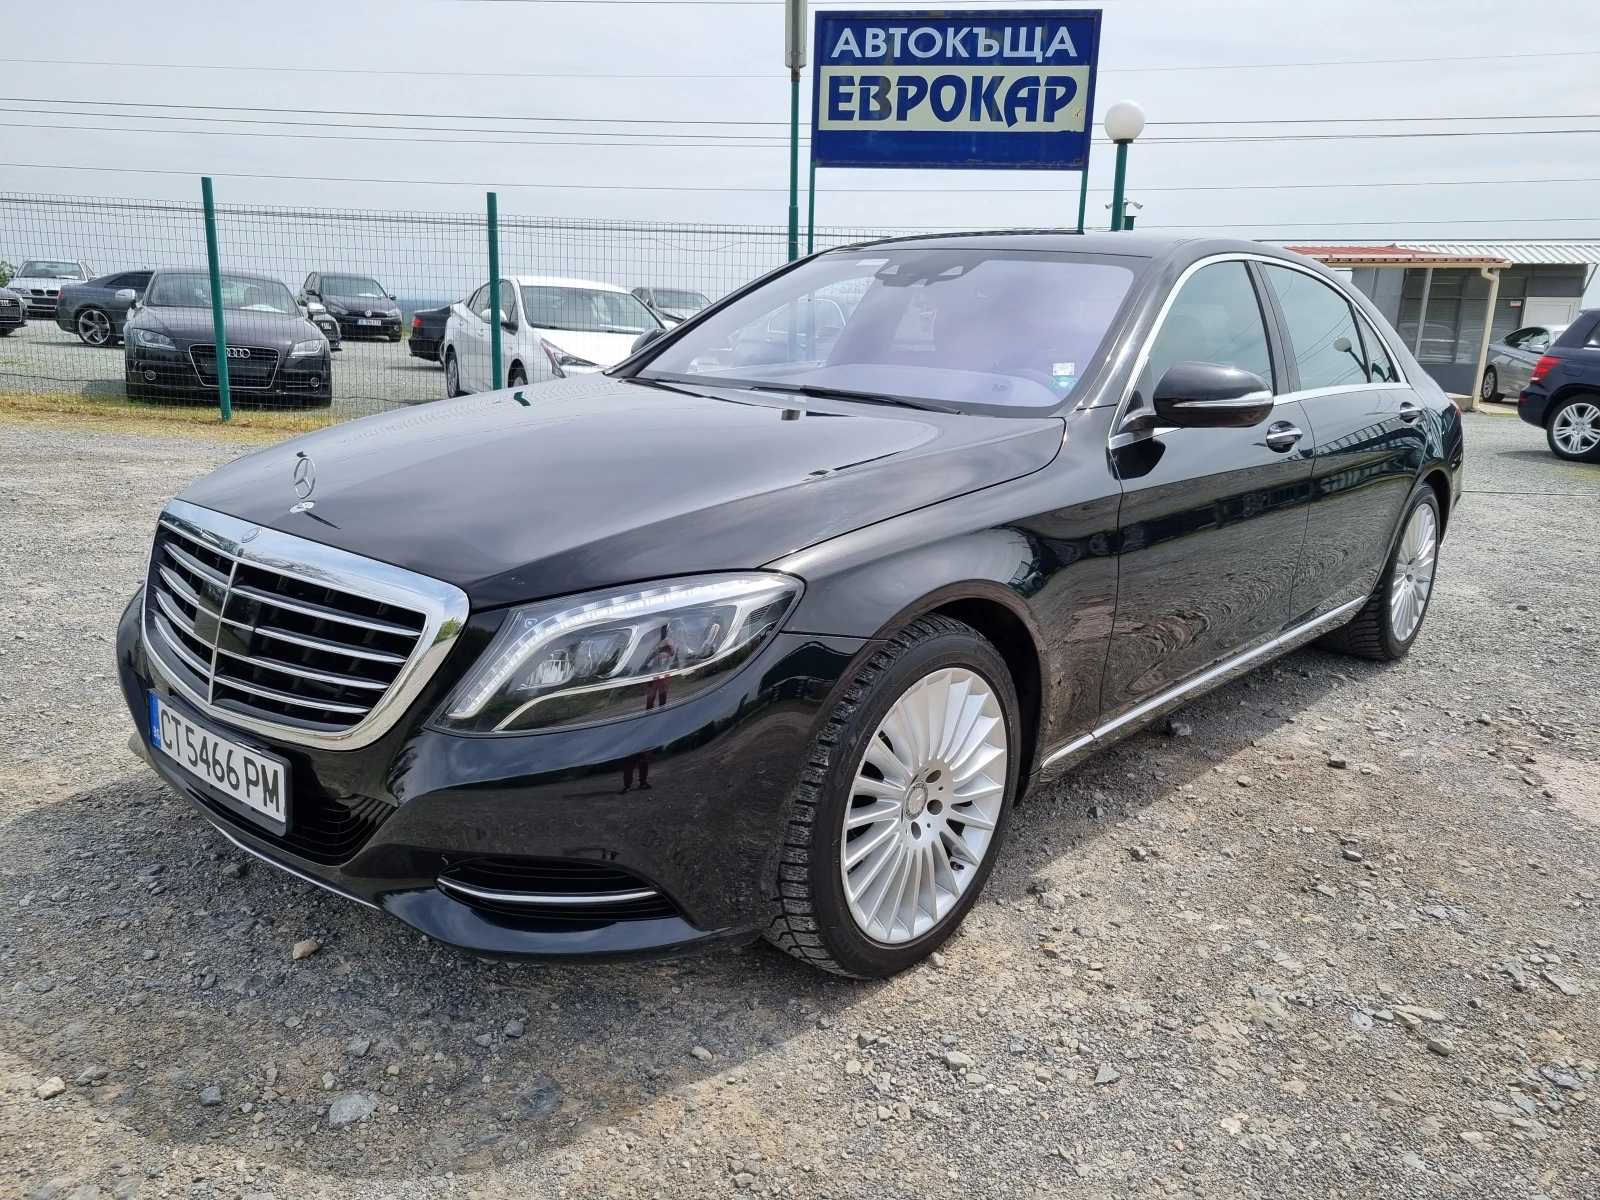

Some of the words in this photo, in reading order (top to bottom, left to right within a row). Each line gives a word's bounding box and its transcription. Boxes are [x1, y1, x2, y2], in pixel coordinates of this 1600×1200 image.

[831, 27, 1077, 63] АВТОКЪЩА
[827, 75, 1077, 128] ЕВРОКАР
[185, 724, 240, 791] 5466
